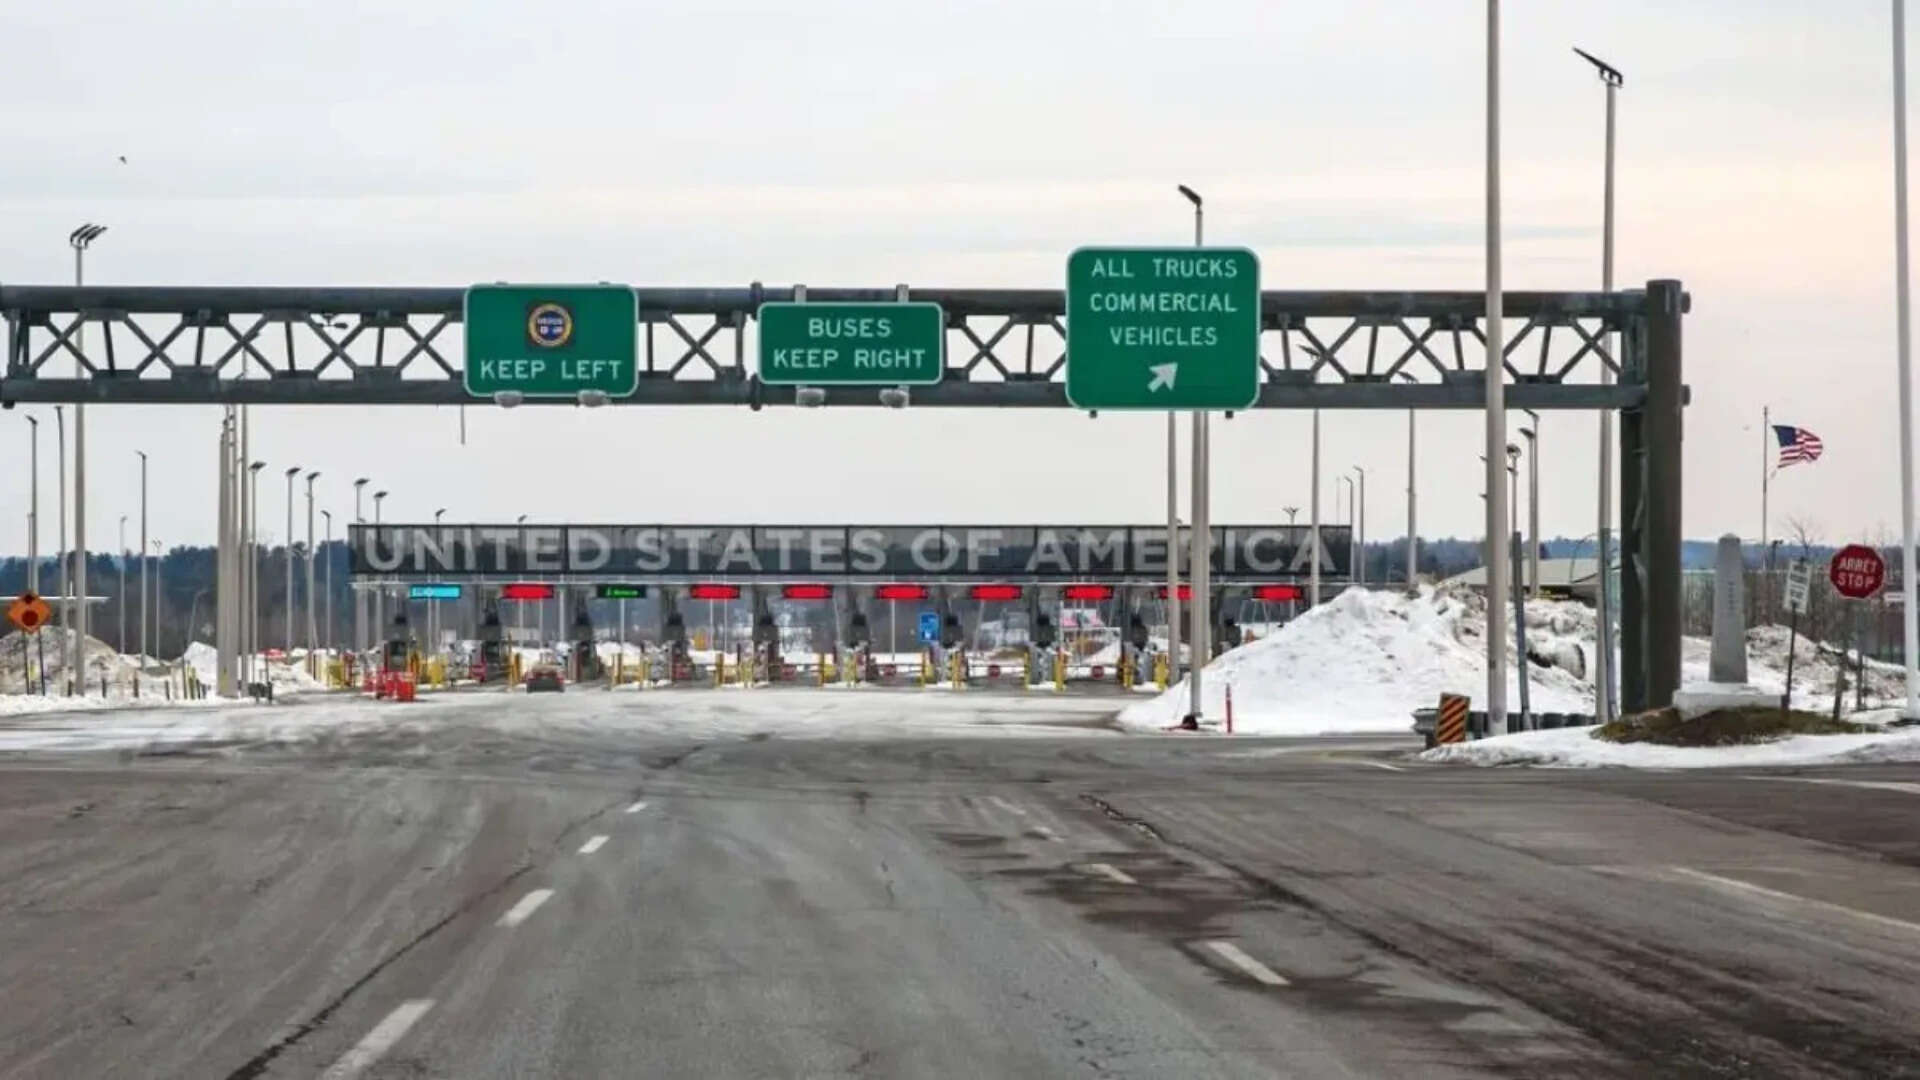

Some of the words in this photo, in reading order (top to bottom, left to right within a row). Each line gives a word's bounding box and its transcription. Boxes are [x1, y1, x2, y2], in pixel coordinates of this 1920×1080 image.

[1091, 258, 1134, 278] ALL
[1153, 258, 1237, 278] TRUCKS
[1090, 292, 1238, 313] COMMERCIAL
[809, 317, 891, 338] BUSES
[1110, 326, 1217, 346] VEHICLES
[774, 349, 839, 369] KEEP
[854, 349, 926, 369] RIGHT
[480, 359, 545, 380] KEEP
[561, 359, 622, 380] LEFT
[364, 528, 612, 572] UNITED
[635, 528, 888, 572] STATES
[910, 528, 1004, 572] OF
[1024, 528, 1337, 572] AMERICA
[1837, 571, 1875, 589] STOP
